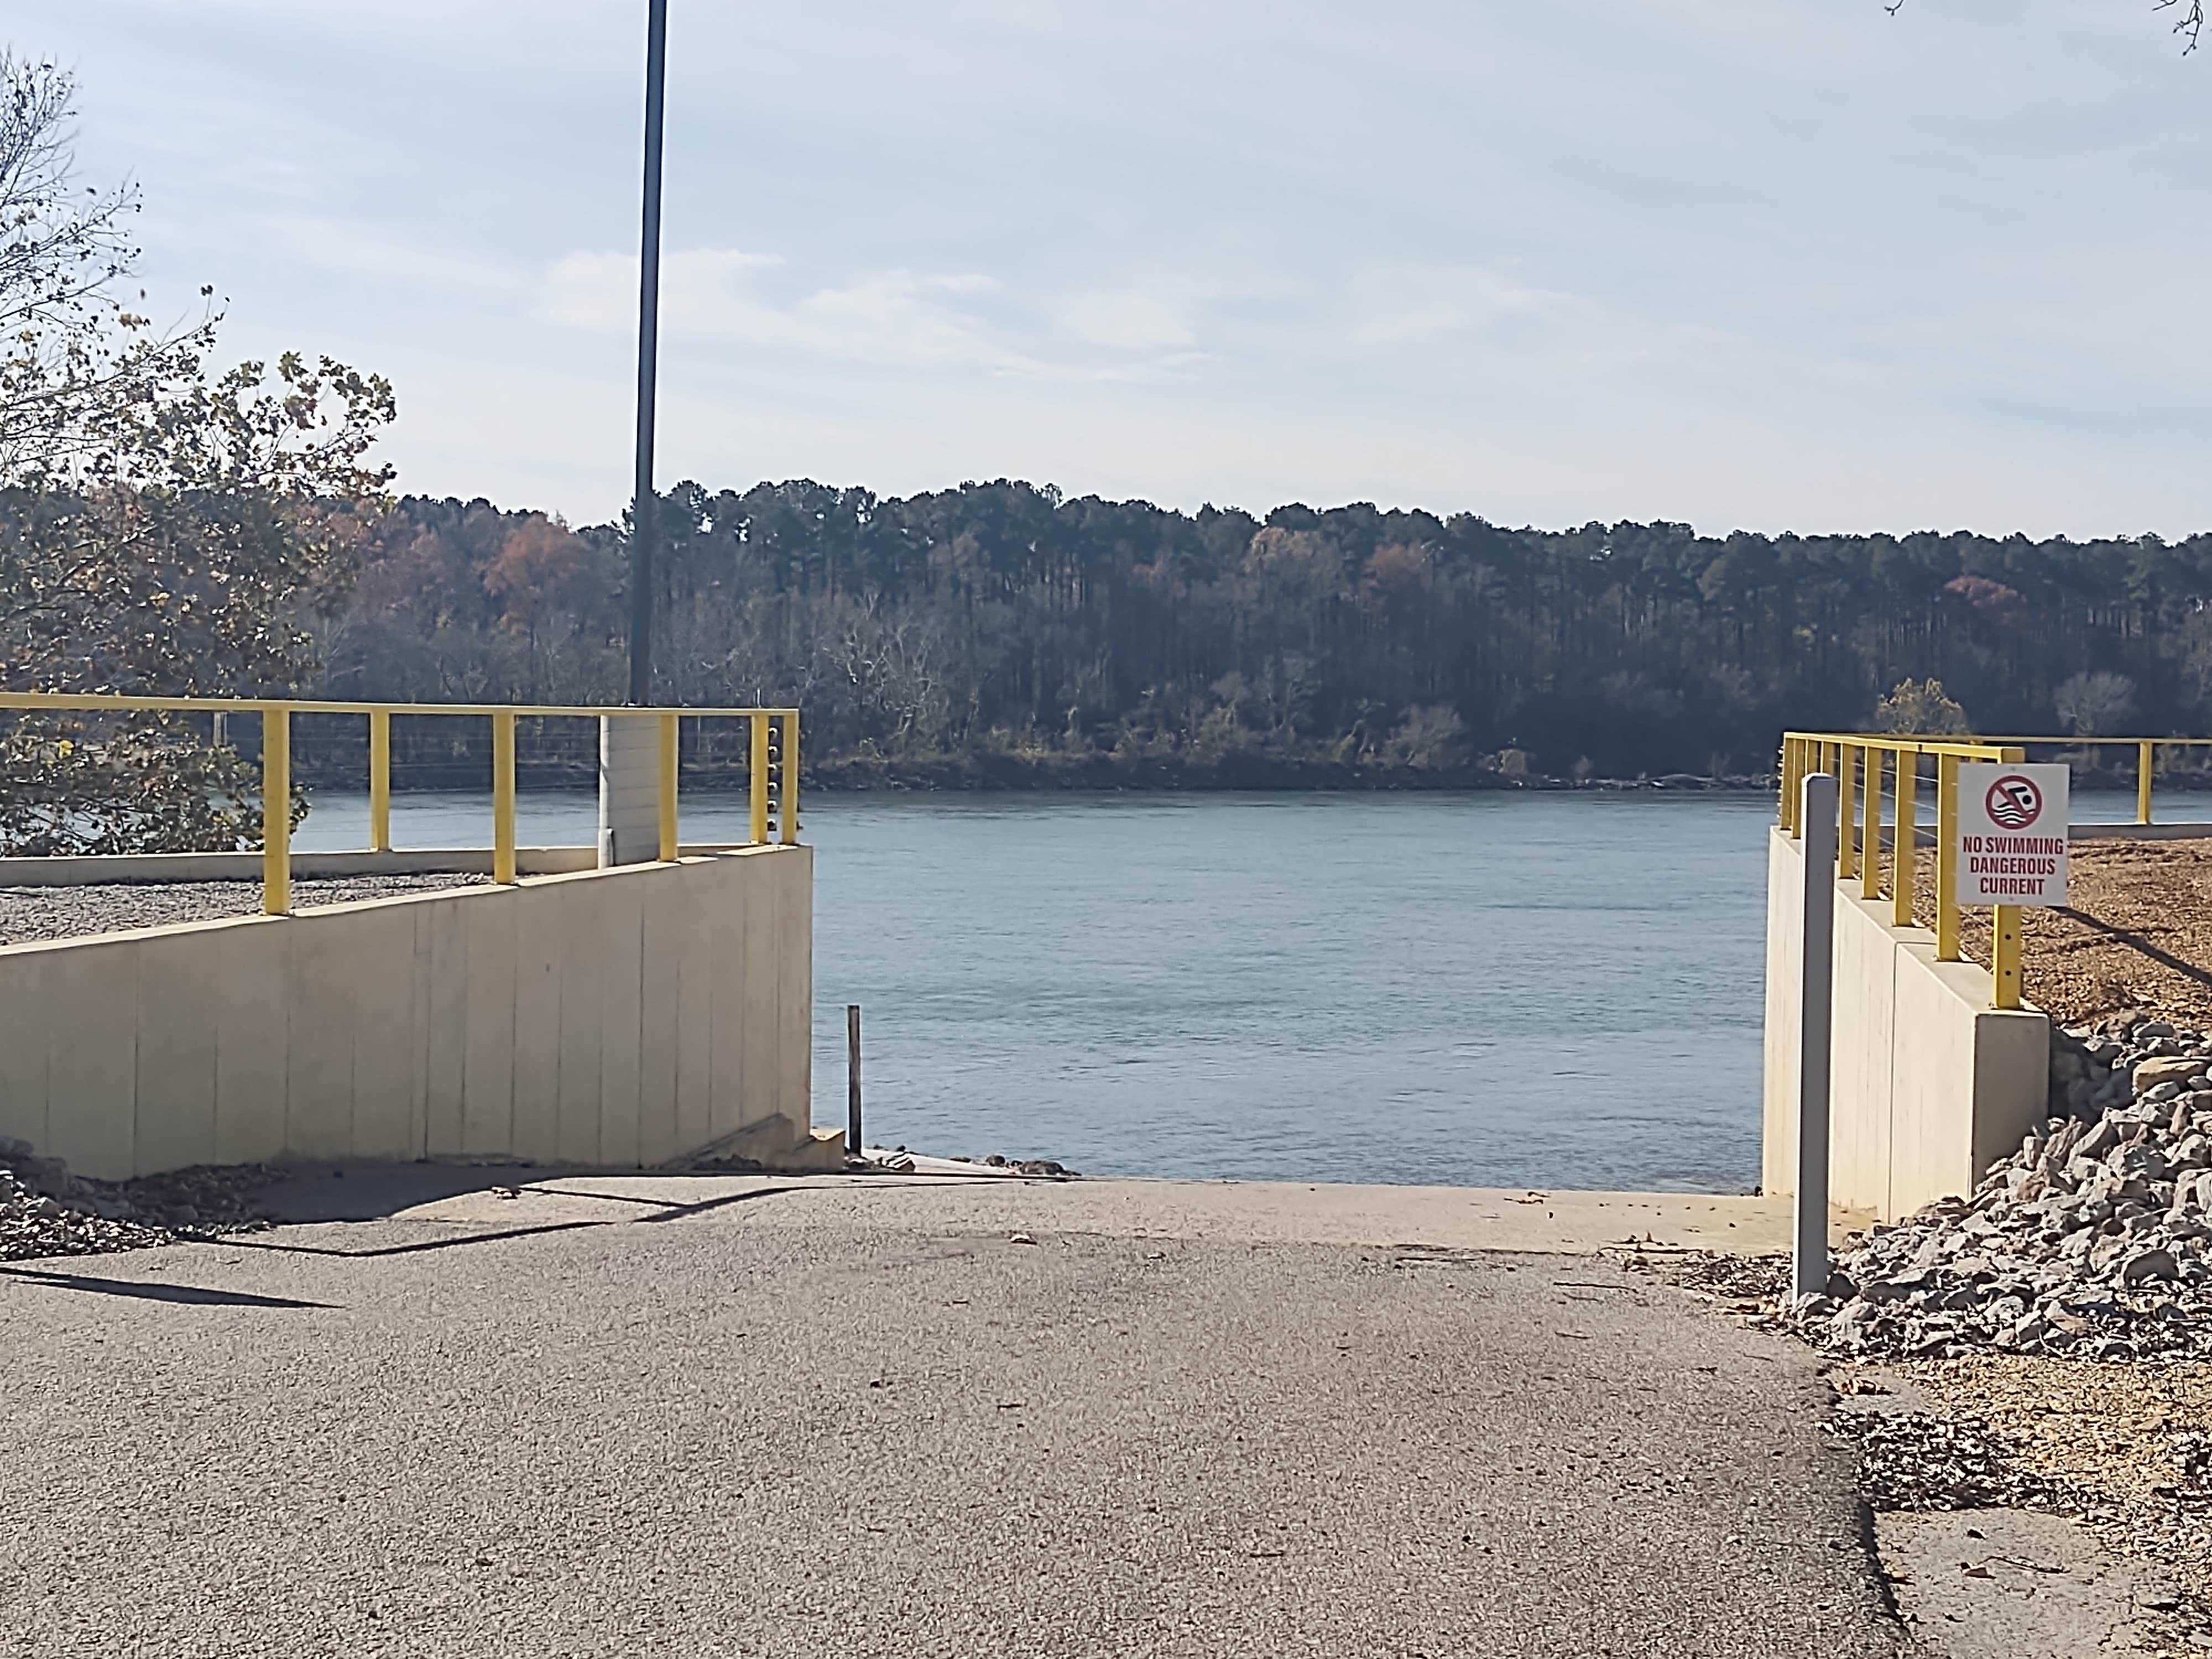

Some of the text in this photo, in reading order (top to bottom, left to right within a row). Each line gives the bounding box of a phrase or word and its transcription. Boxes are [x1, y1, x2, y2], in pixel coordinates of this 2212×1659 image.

[1963, 836, 2064, 854] NO SWIMMING
[1970, 857, 2056, 875] DANGEROUS
[1980, 878, 2045, 895] CURRENT
